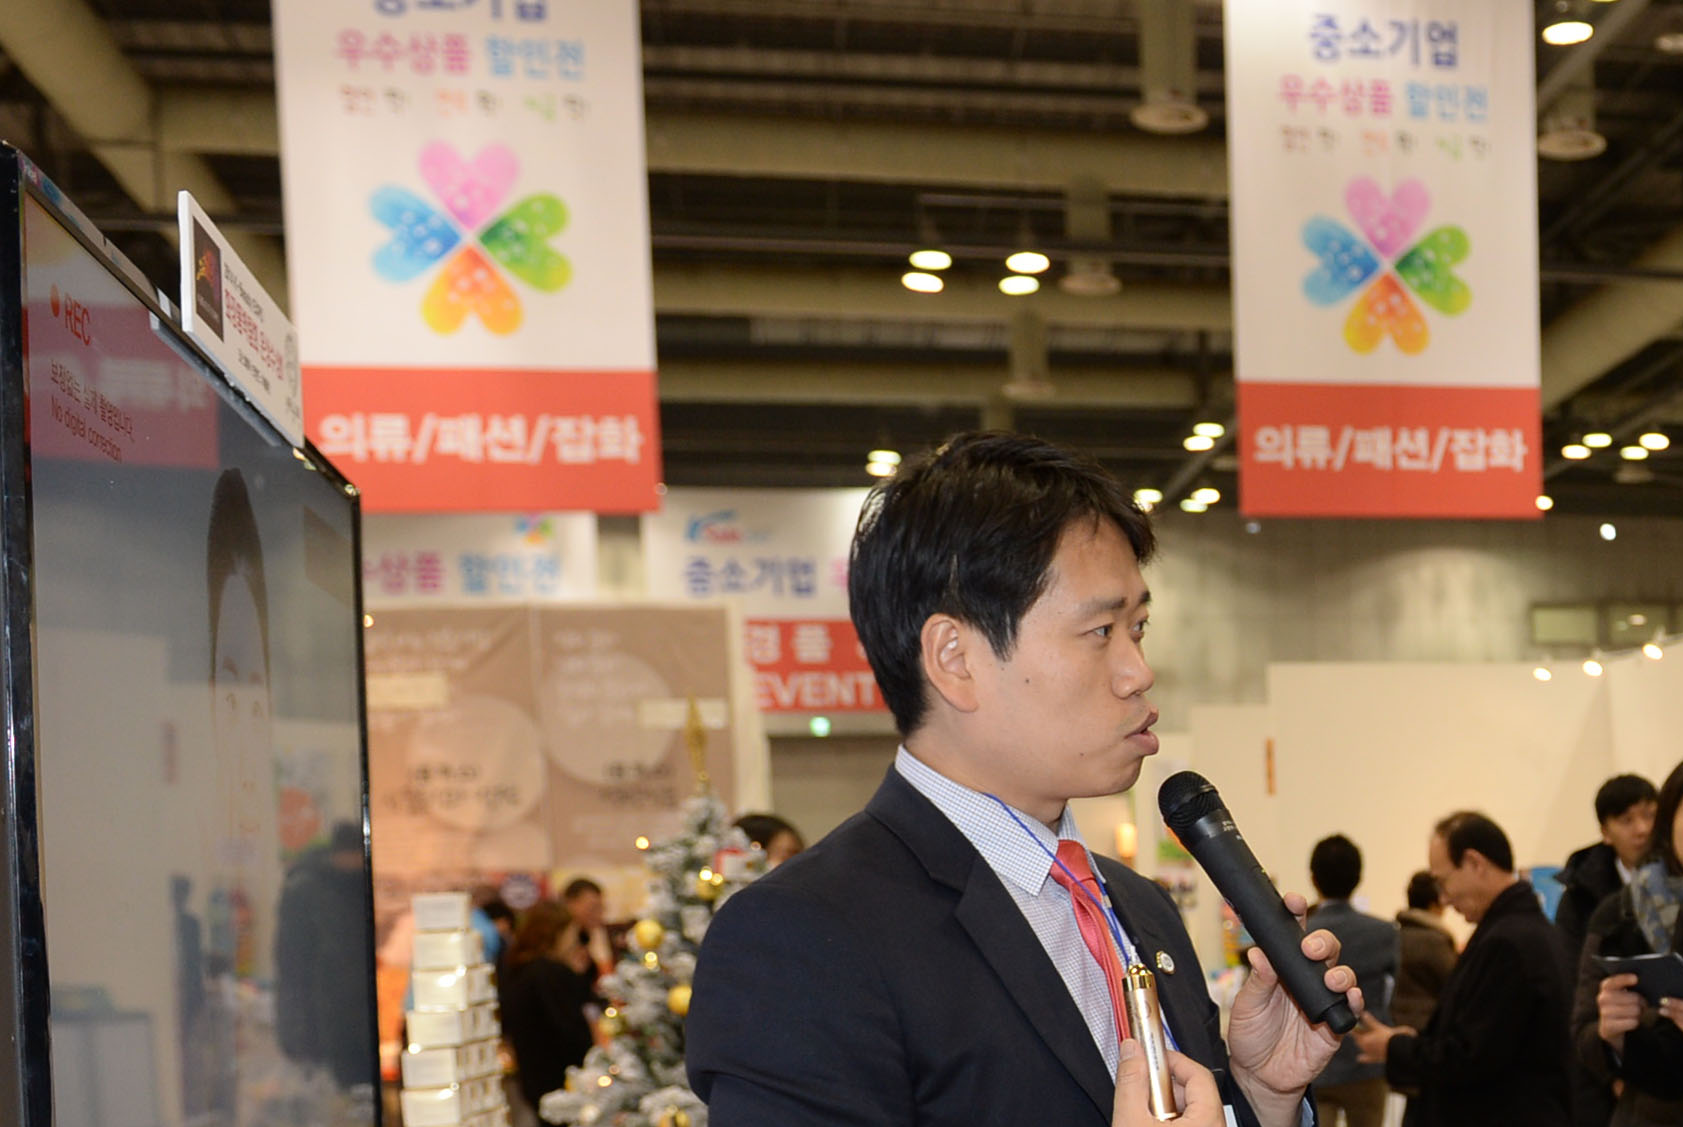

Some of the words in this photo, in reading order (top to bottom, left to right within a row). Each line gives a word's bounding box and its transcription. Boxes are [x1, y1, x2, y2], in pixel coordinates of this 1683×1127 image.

[335, 28, 471, 76] 우수상품
[487, 35, 585, 80] 할인전
[1310, 13, 1459, 68] 중소기업
[1276, 74, 1393, 120] 우수상품
[1405, 82, 1490, 122] 할인전
[64, 292, 91, 345] REC
[51, 397, 63, 423] No
[64, 408, 87, 440] digital
[317, 412, 644, 465] 의류/패션/잡화
[1253, 424, 1527, 473] 의류/패션/잡화
[754, 671, 878, 708] EVENT
